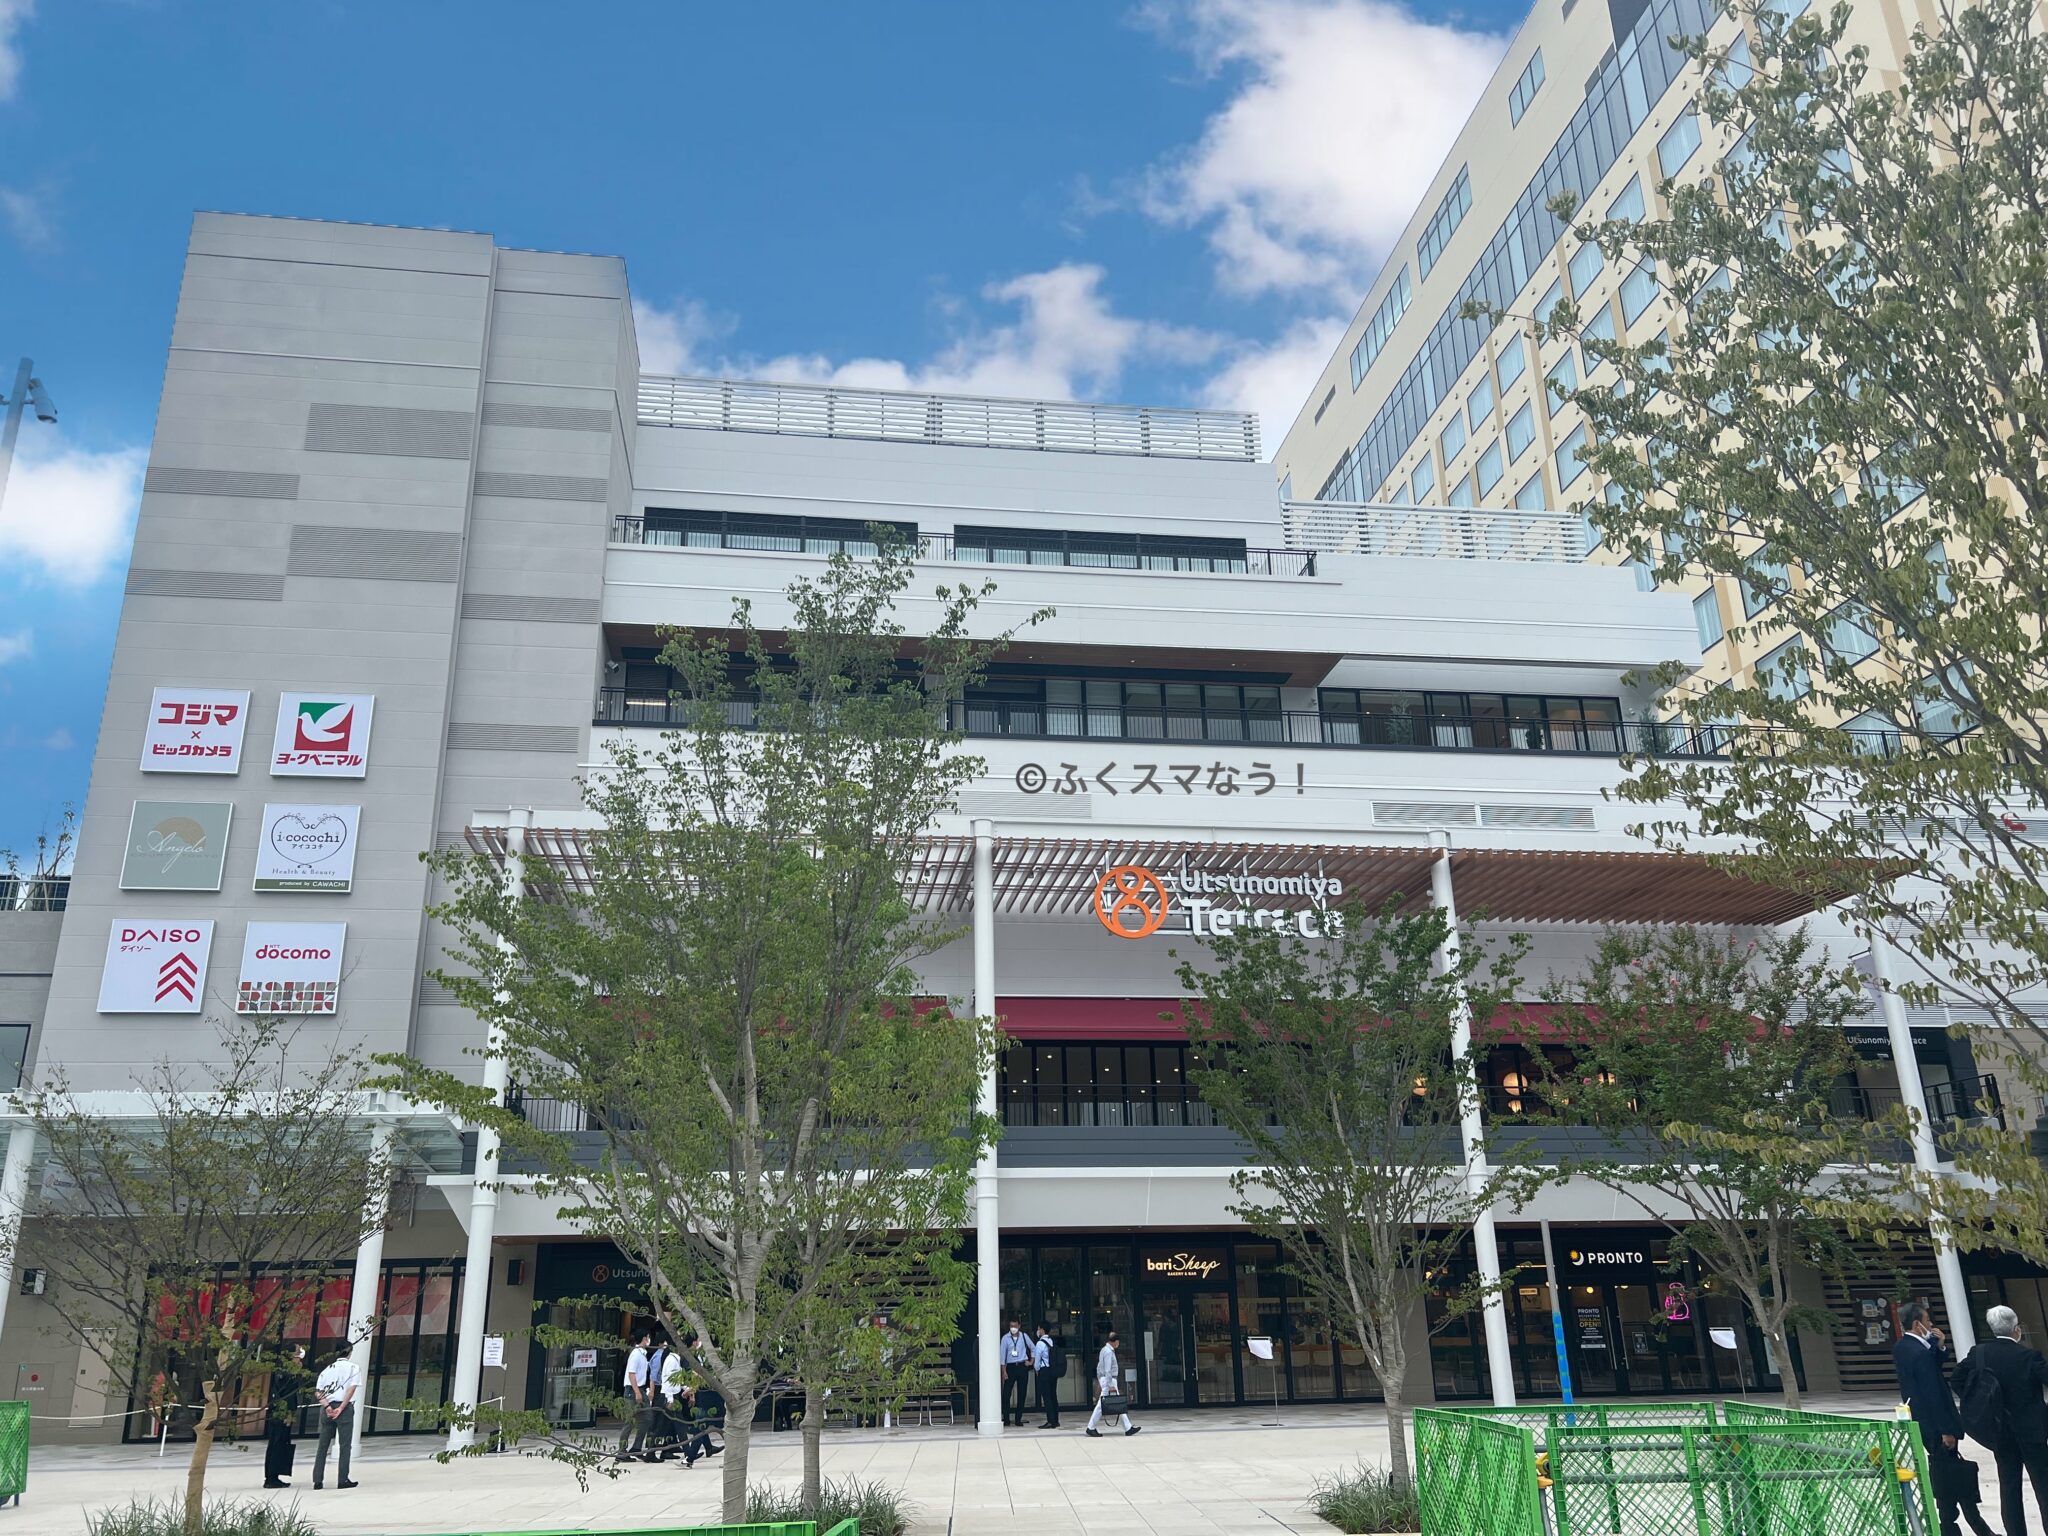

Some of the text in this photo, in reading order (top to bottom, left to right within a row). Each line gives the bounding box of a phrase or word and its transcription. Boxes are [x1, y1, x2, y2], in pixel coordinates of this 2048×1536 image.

[158, 703, 239, 726] コジマ
[152, 744, 233, 757] ビックカメラ
[276, 753, 363, 767] ヨークベニマル
[310, 869, 336, 877] Beauty
[1180, 869, 1343, 900] Utsunomiya
[1181, 898, 1345, 939] Terrace
[121, 928, 201, 943] DAISO
[255, 944, 331, 960] docomo
[1847, 1036, 1892, 1046] Utsunomiy
[1587, 1252, 1643, 1264] PRONTO
[1146, 1253, 1221, 1279] bari Sheep
